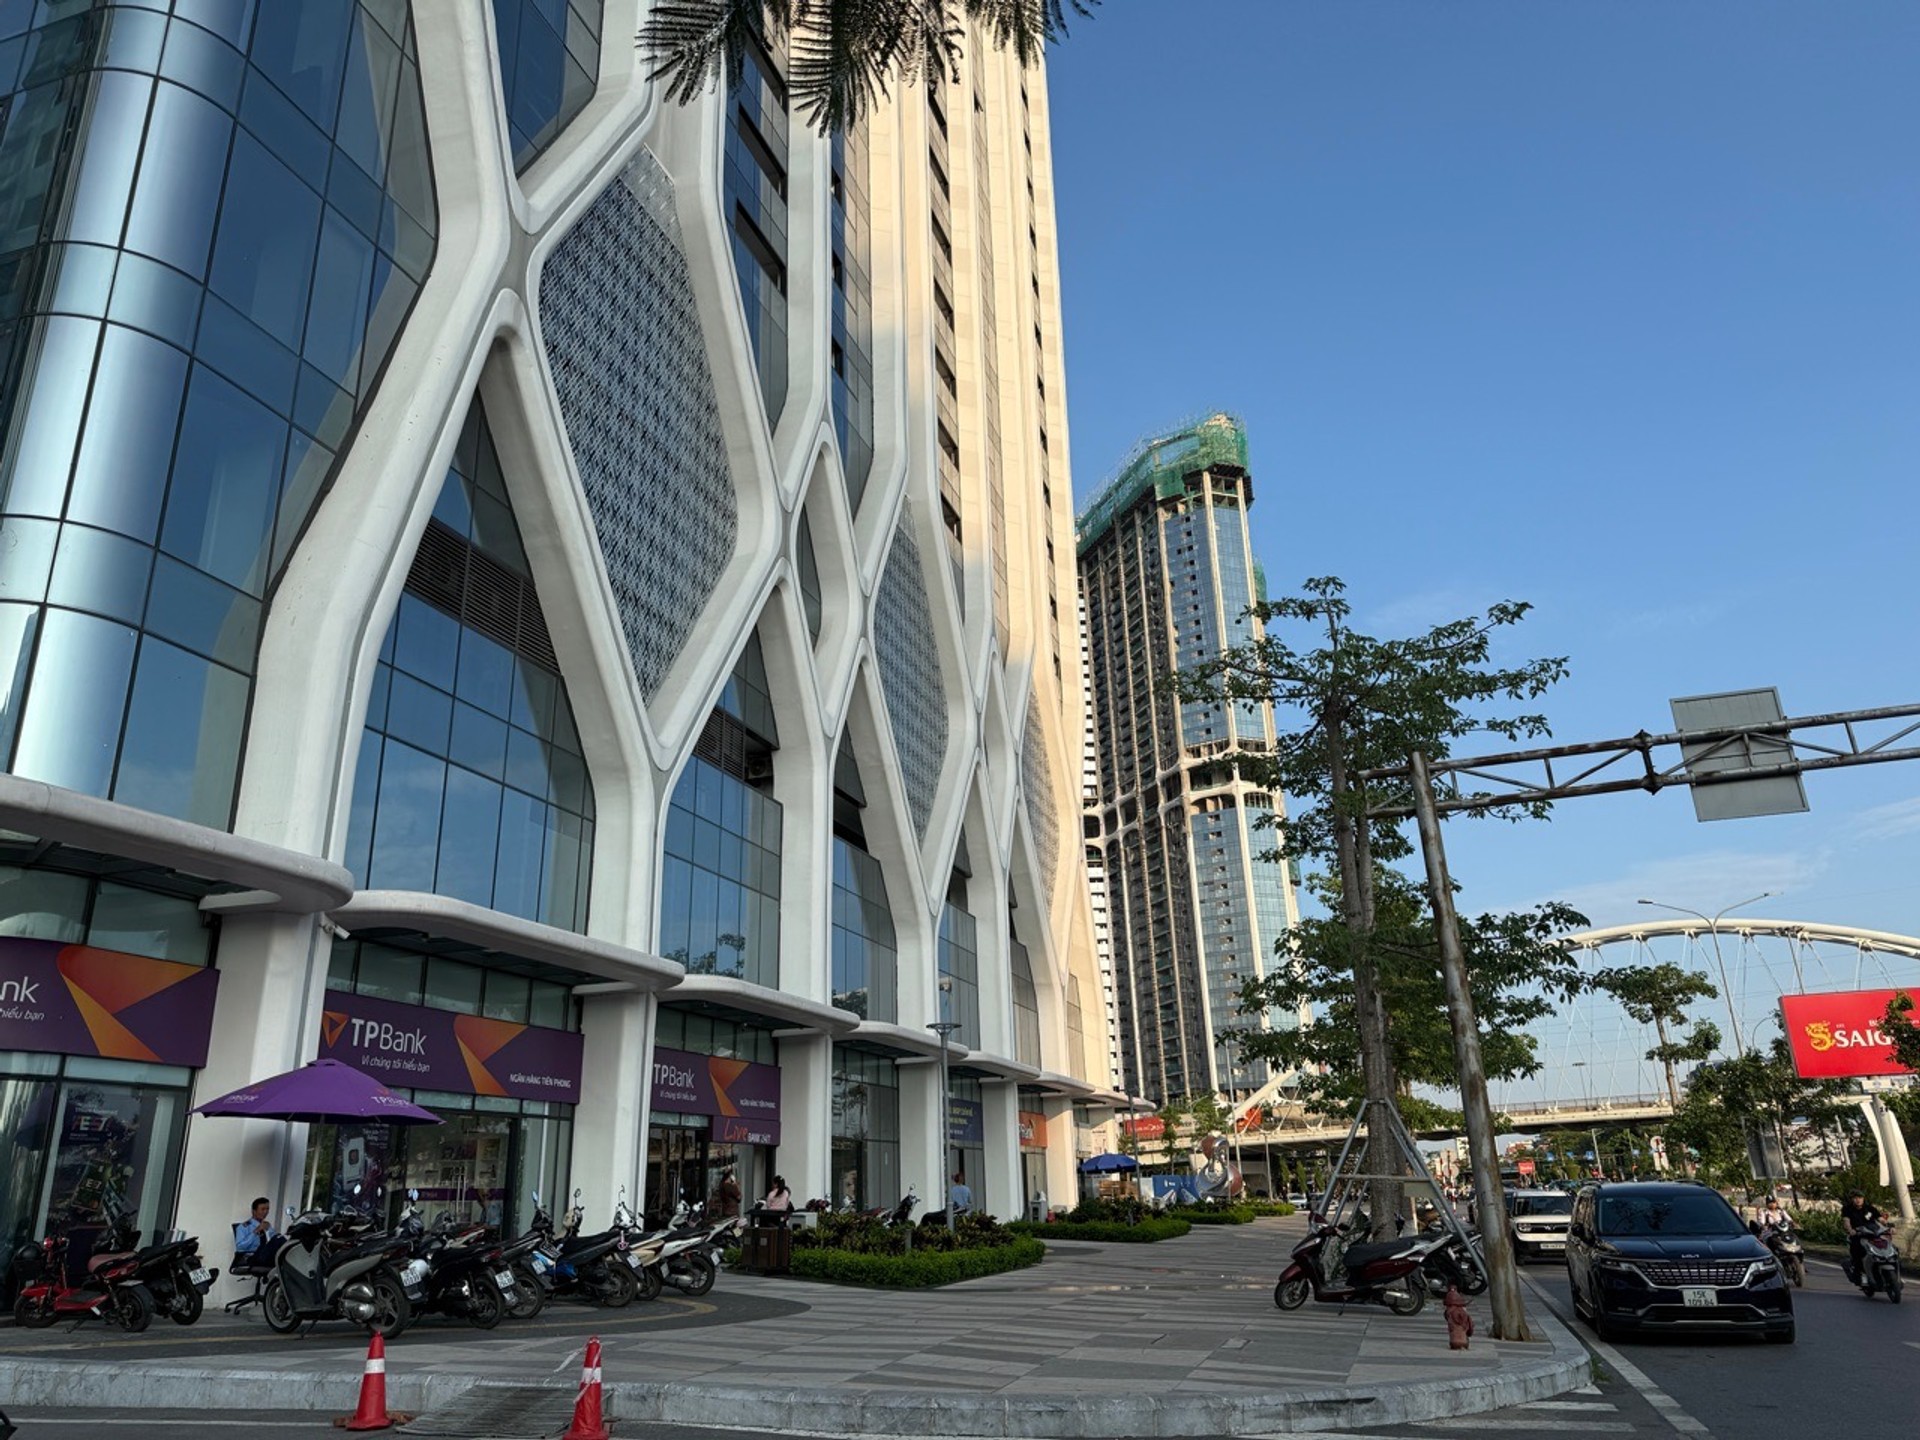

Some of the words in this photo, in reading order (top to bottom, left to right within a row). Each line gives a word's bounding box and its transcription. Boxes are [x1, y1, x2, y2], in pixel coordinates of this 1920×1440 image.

[0, 976, 40, 1003] nk
[351, 1018, 427, 1055] TPBank
[1834, 1028, 1896, 1048] SAIG
[654, 1063, 695, 1088] TPBank
